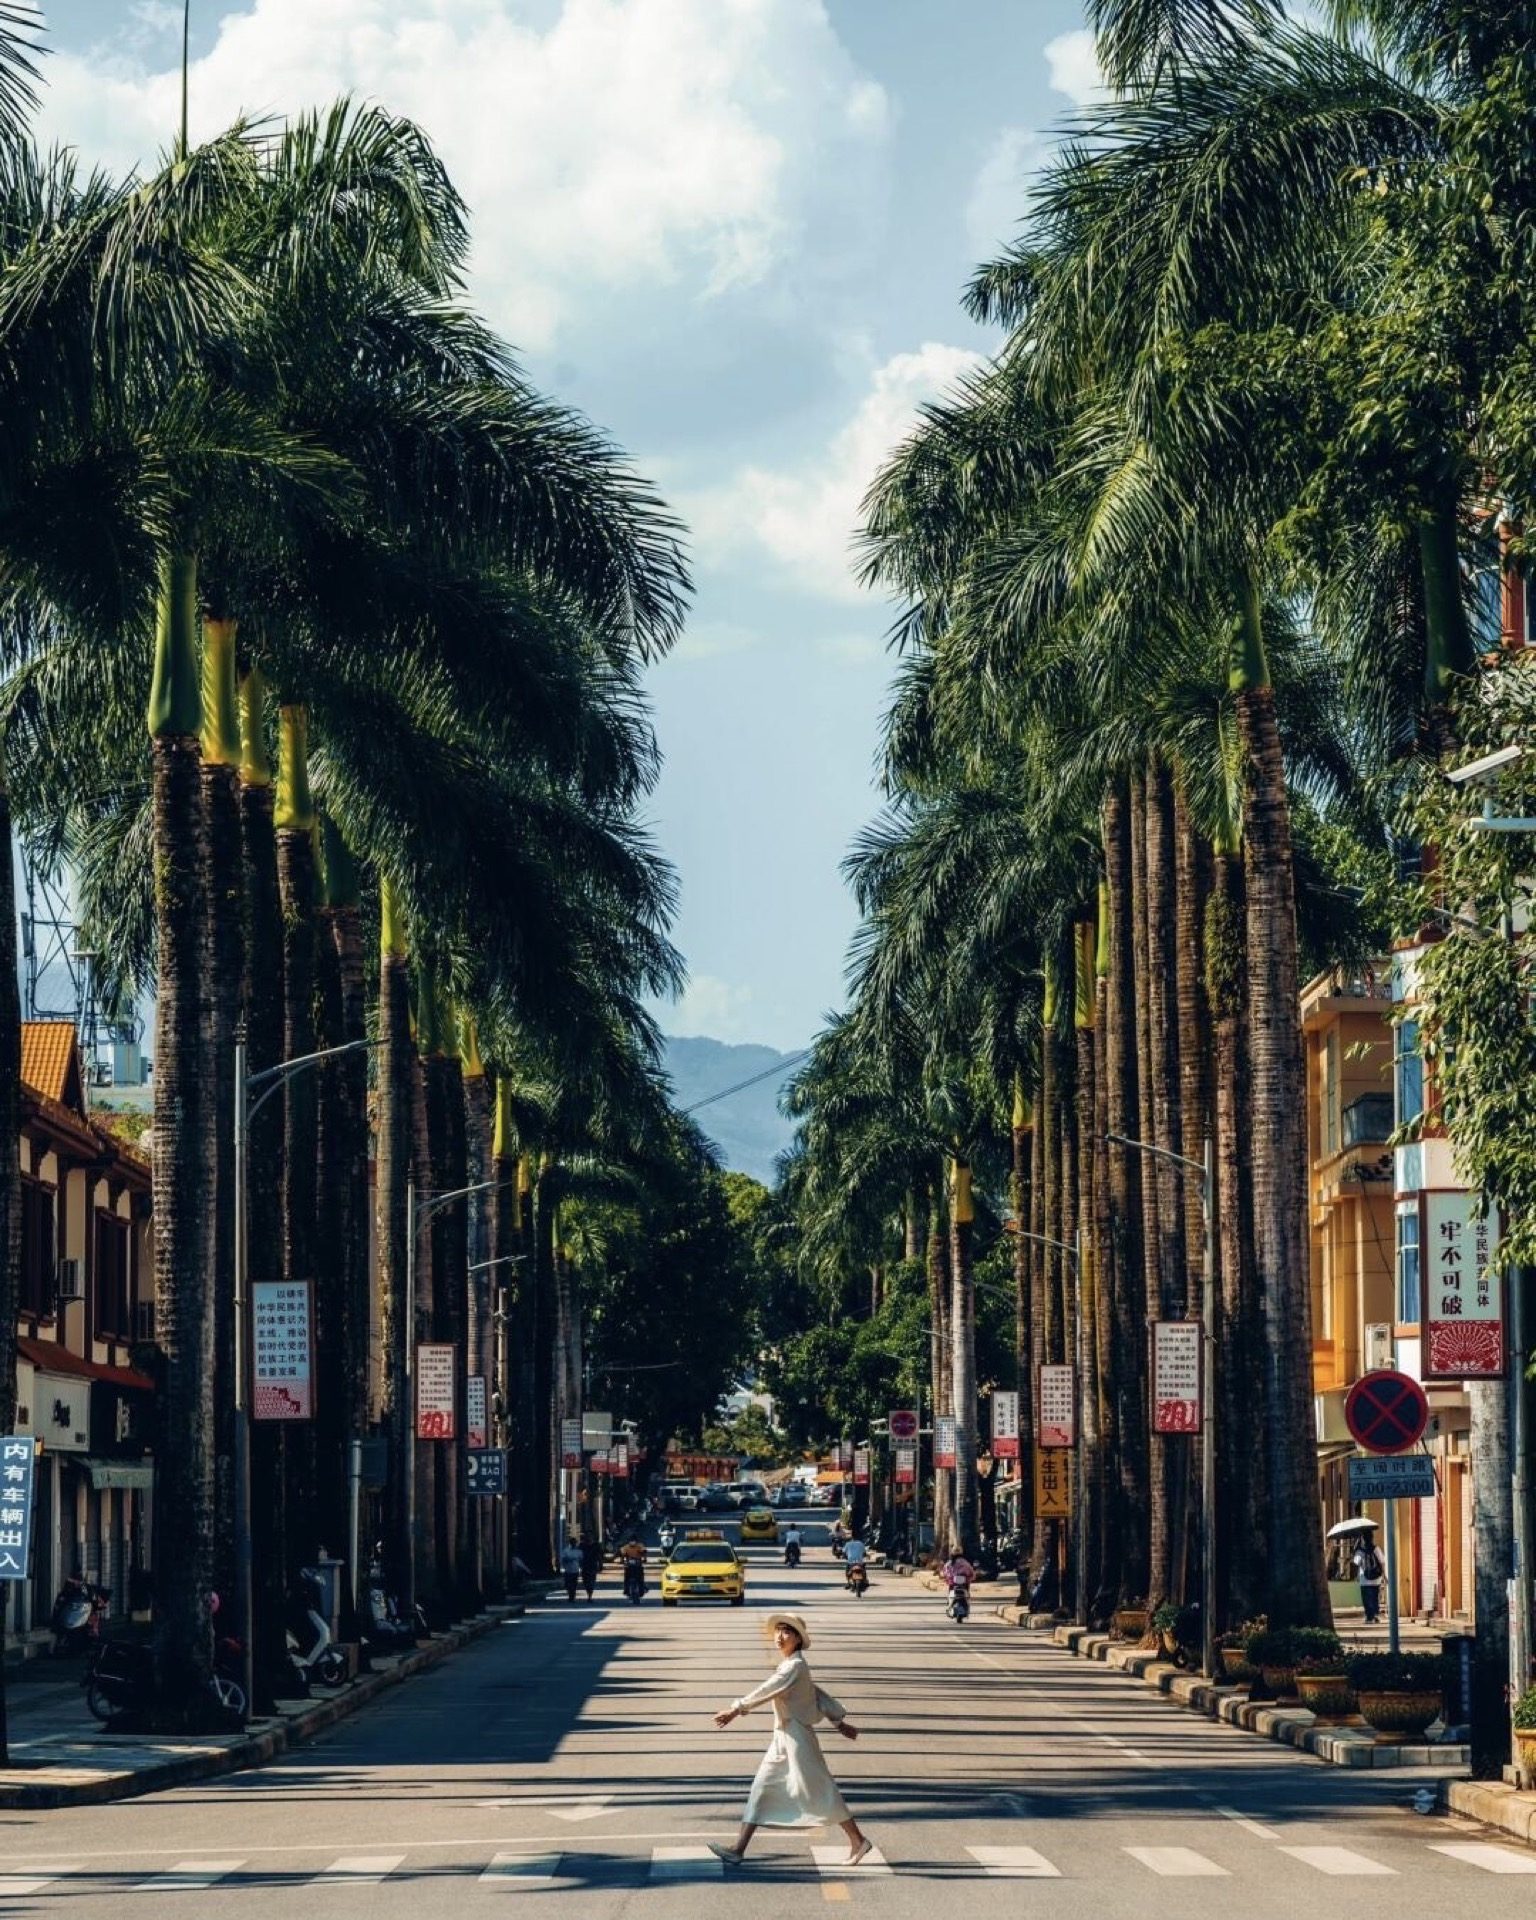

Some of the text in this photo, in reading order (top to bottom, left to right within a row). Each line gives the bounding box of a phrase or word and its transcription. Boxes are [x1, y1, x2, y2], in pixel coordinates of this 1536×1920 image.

[1440, 1220, 1463, 1315] 牢不可破
[0, 1443, 29, 1570] 内有车辆出入
